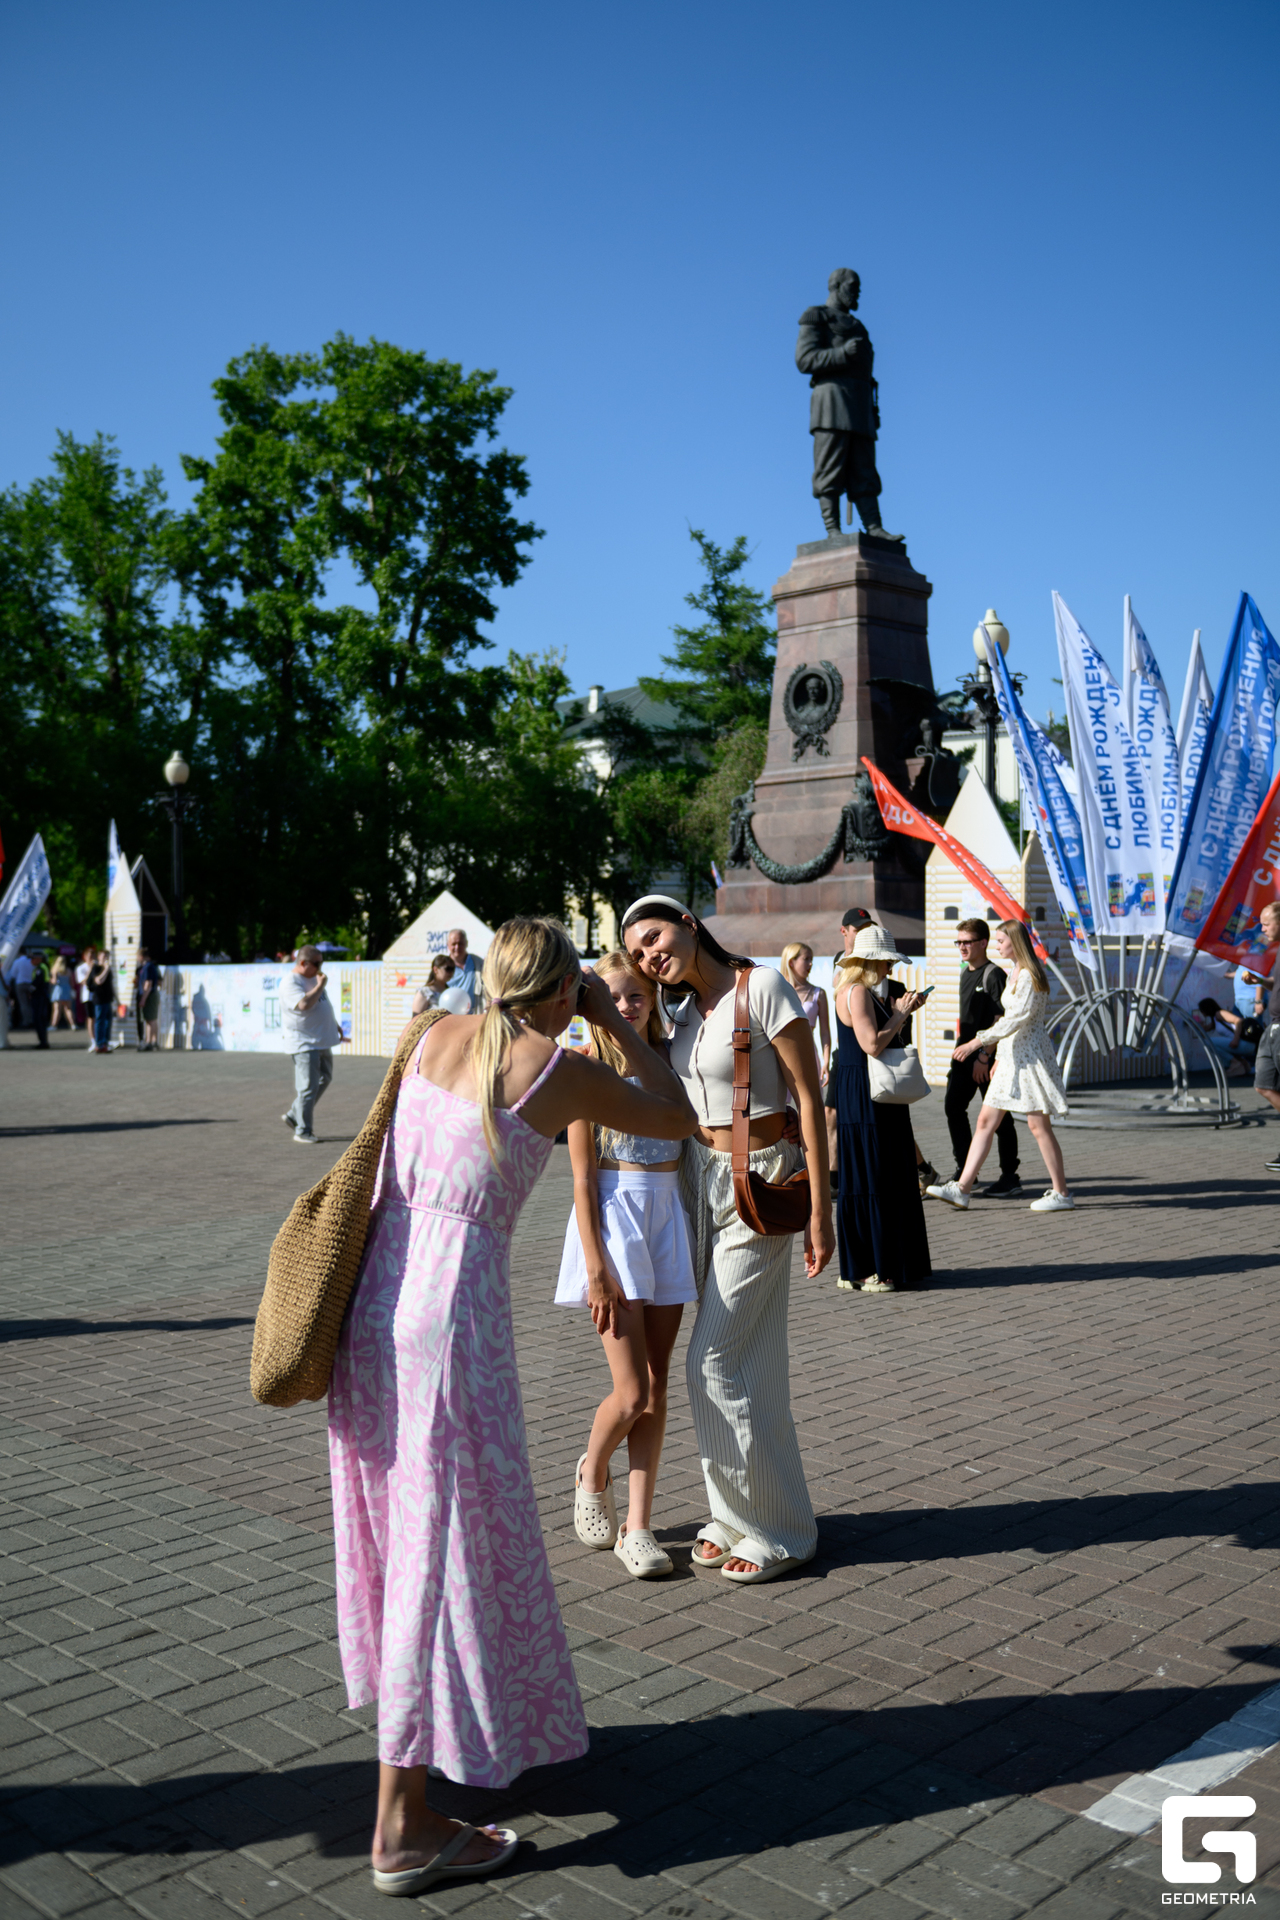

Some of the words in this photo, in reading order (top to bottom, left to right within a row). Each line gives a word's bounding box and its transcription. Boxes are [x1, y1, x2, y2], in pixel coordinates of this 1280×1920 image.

[1222, 626, 1263, 767] РОЖДЕНИЯ
[1094, 765, 1123, 830] ДНЁМ
[1206, 772, 1237, 841] ДНЁМ
[1228, 733, 1271, 862] ЛЮБИМЫЙ
[1063, 842, 1080, 858] С
[1105, 836, 1121, 850] С
[1201, 836, 1218, 858] С
[1253, 868, 1273, 886] С
